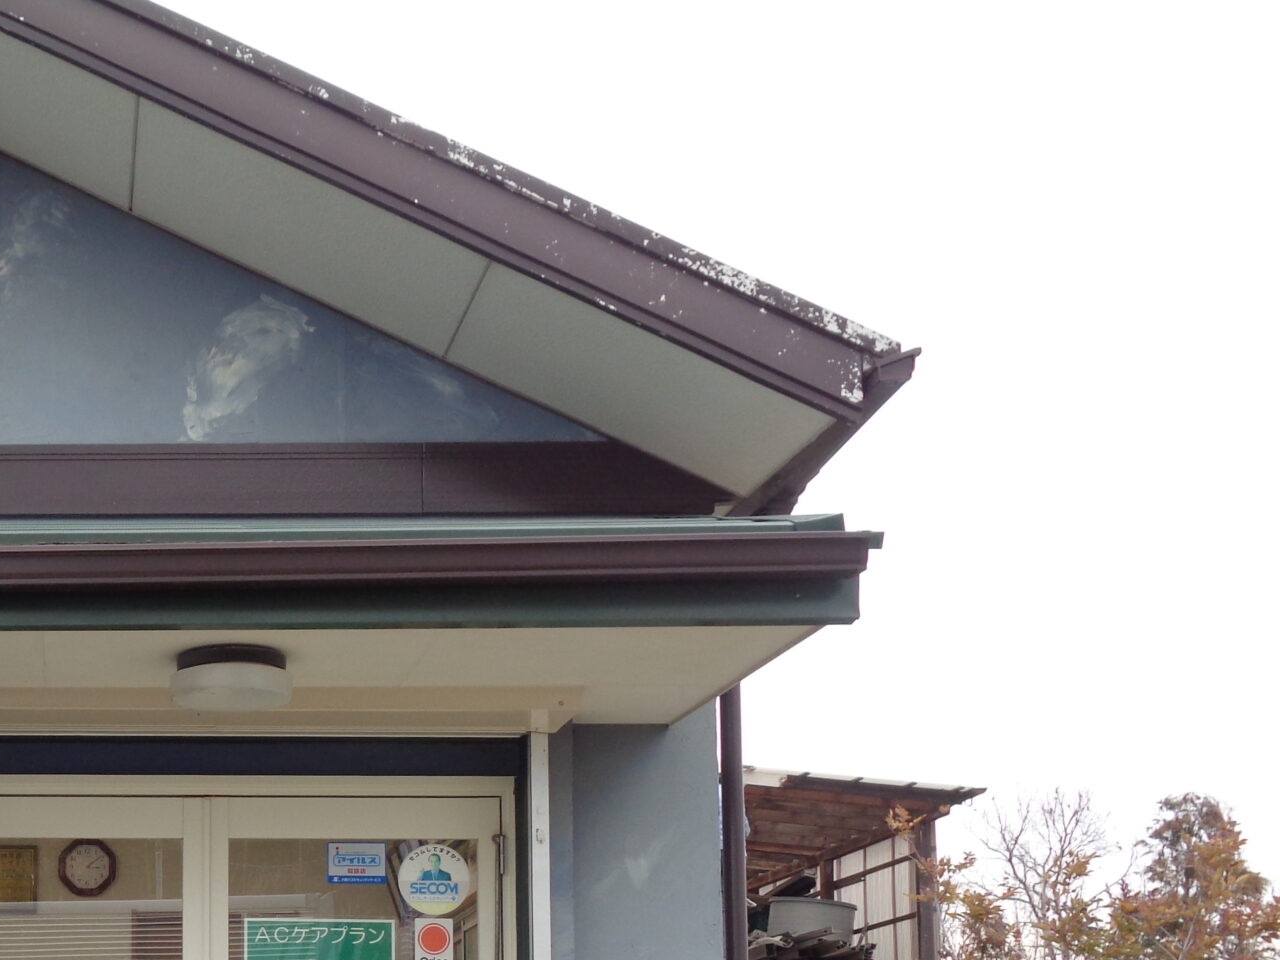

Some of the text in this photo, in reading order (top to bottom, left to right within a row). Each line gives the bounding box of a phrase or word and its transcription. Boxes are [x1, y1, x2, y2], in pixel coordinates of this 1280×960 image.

[410, 882, 459, 895] SECOM
[255, 925, 385, 944] ACケアプラン
